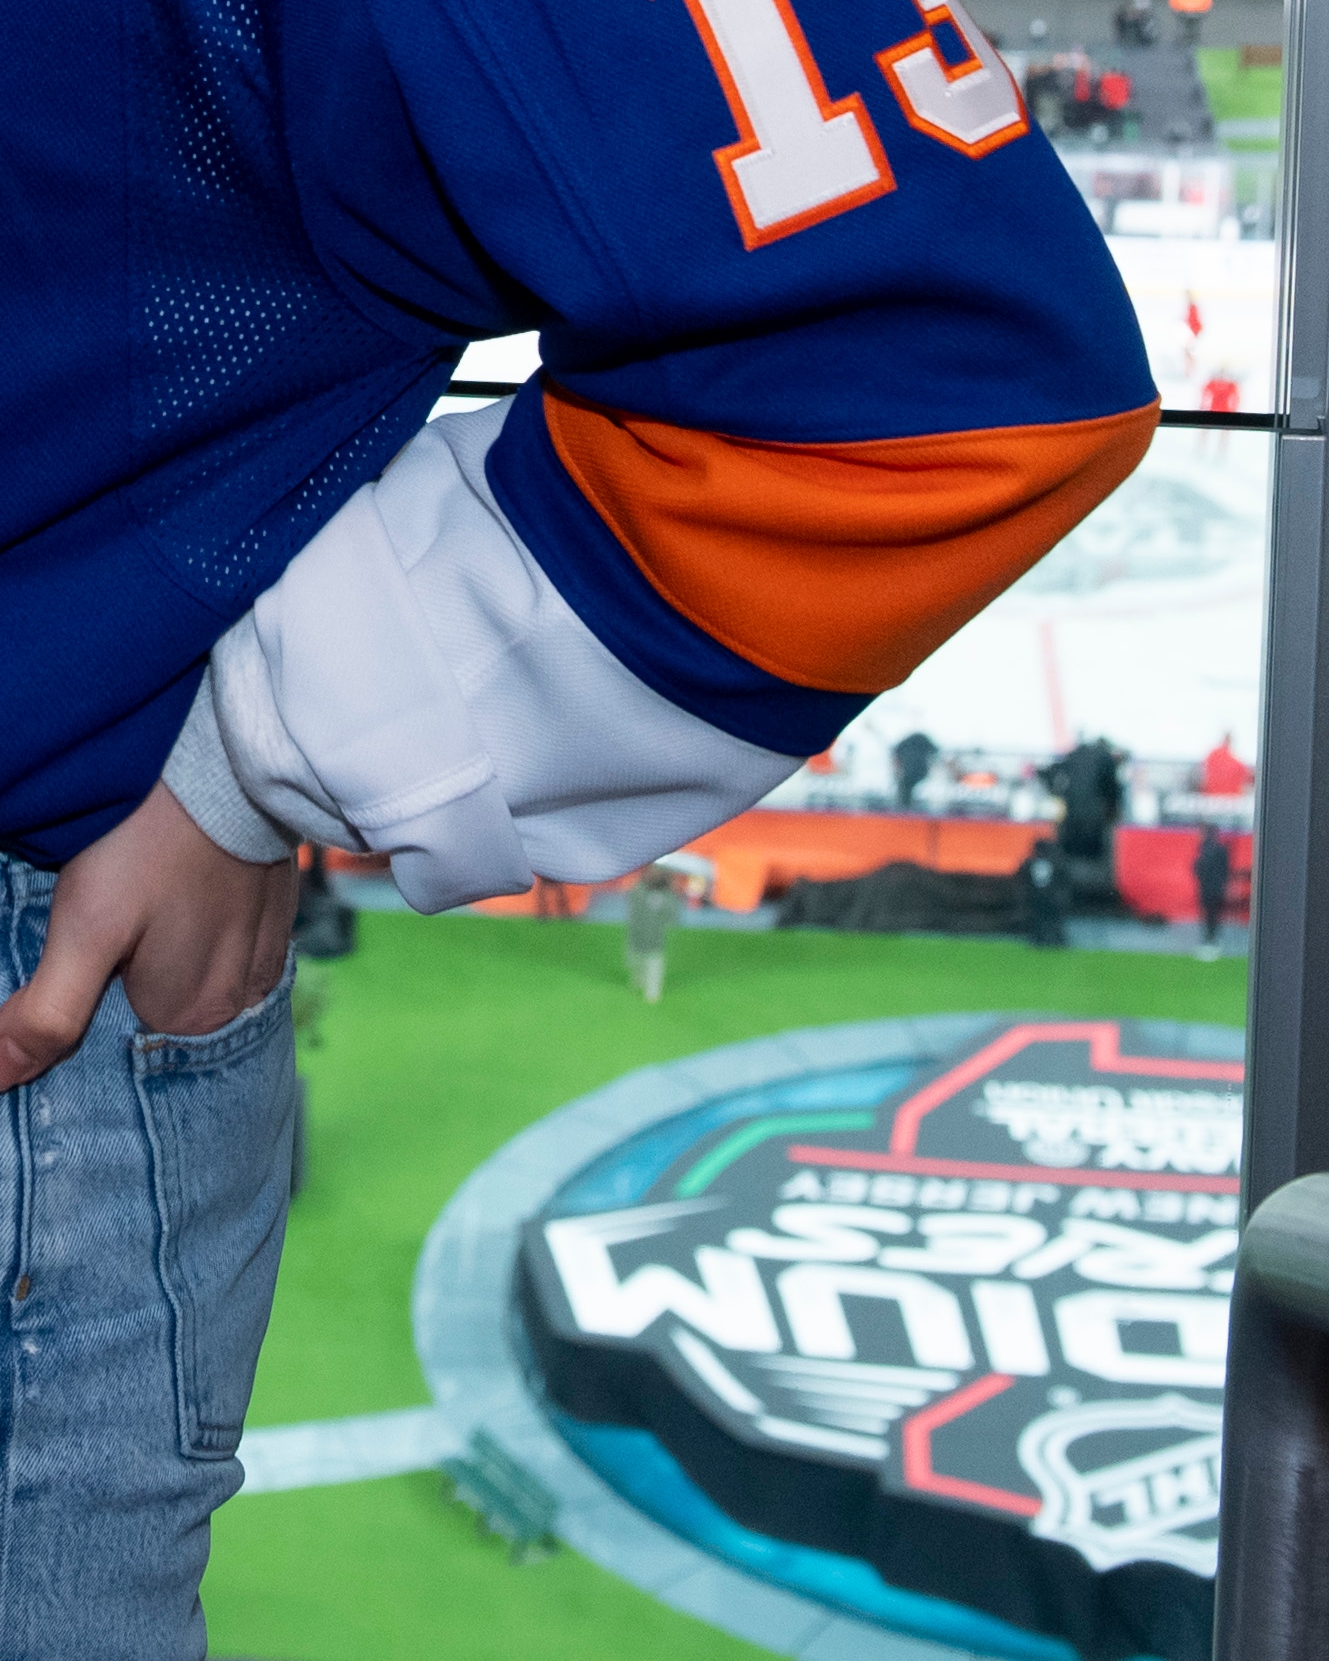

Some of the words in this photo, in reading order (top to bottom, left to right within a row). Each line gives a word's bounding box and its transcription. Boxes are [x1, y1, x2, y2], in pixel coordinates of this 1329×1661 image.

[726, 1203, 1238, 1291] RIES
[545, 1220, 1229, 1389] DIUM
[1095, 1452, 1222, 1523] HL
